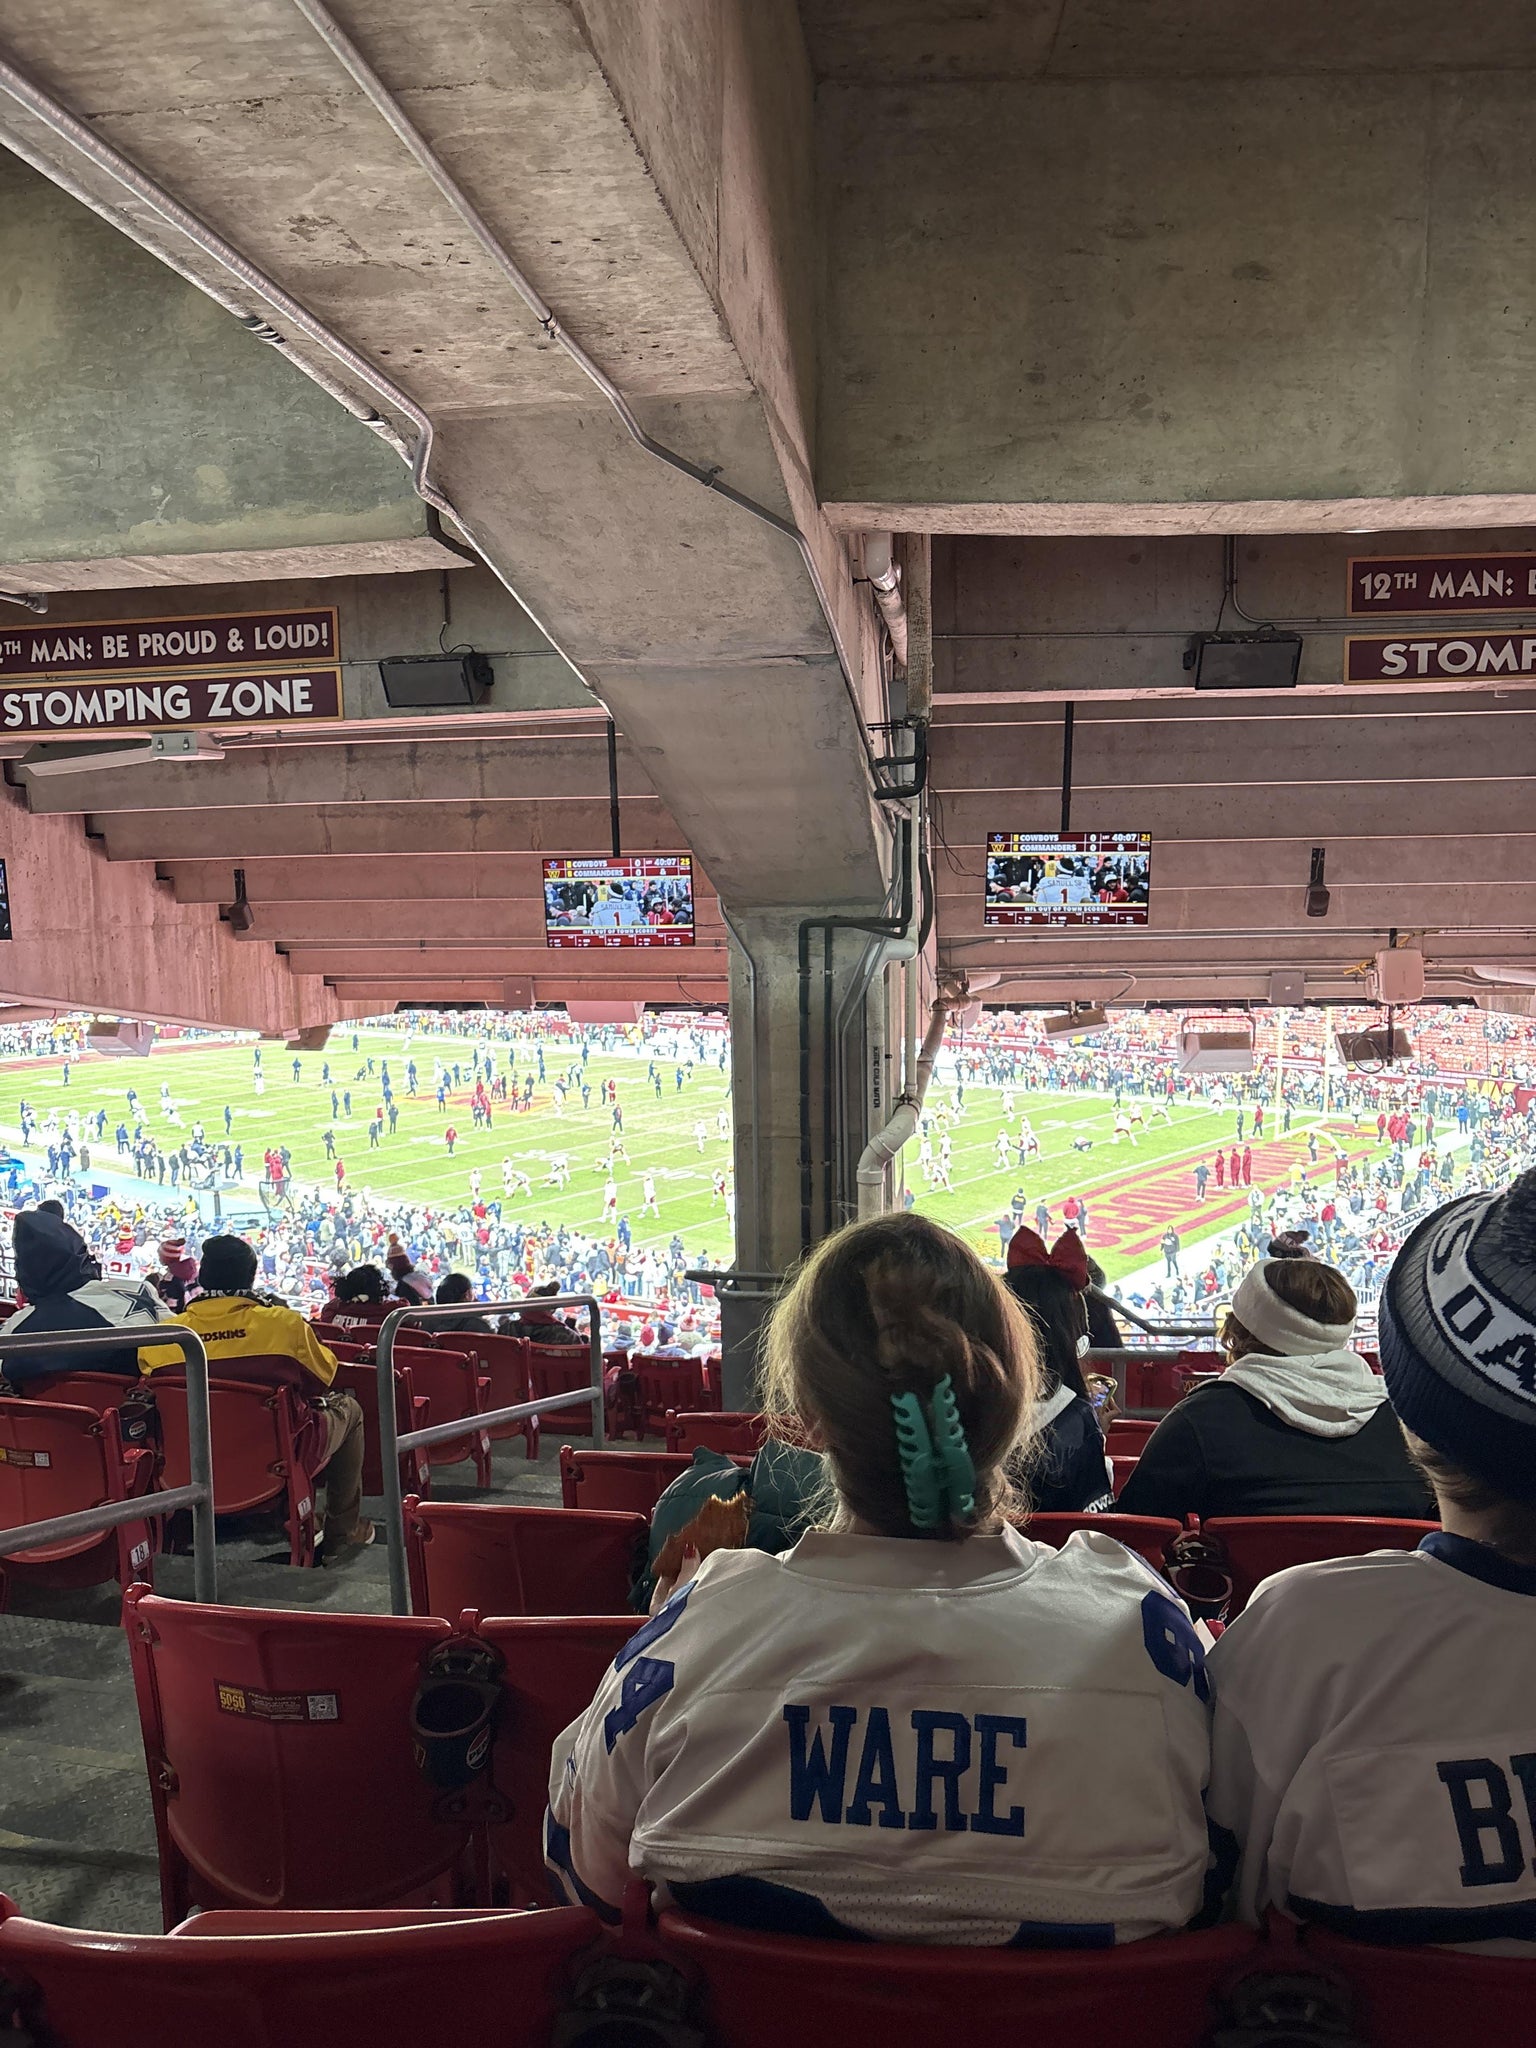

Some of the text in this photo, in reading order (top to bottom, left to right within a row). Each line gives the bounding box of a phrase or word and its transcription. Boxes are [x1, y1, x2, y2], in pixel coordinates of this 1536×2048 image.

[1359, 573, 1417, 600] 12TH
[1428, 569, 1514, 599] MAN:
[30, 637, 93, 663] MAN:
[102, 634, 129, 659] BE
[138, 630, 217, 657] PROUD
[227, 628, 245, 652] &
[254, 622, 329, 651] LOUD!
[4, 679, 314, 727] STOMPING ZONE
[1020, 834, 1059, 842] COWBOYS
[1020, 844, 1077, 852] COMMANDERS
[573, 869, 624, 878] COMMANDERS
[135, 1544, 145, 1560] 18
[783, 1704, 1027, 1837] WARE
